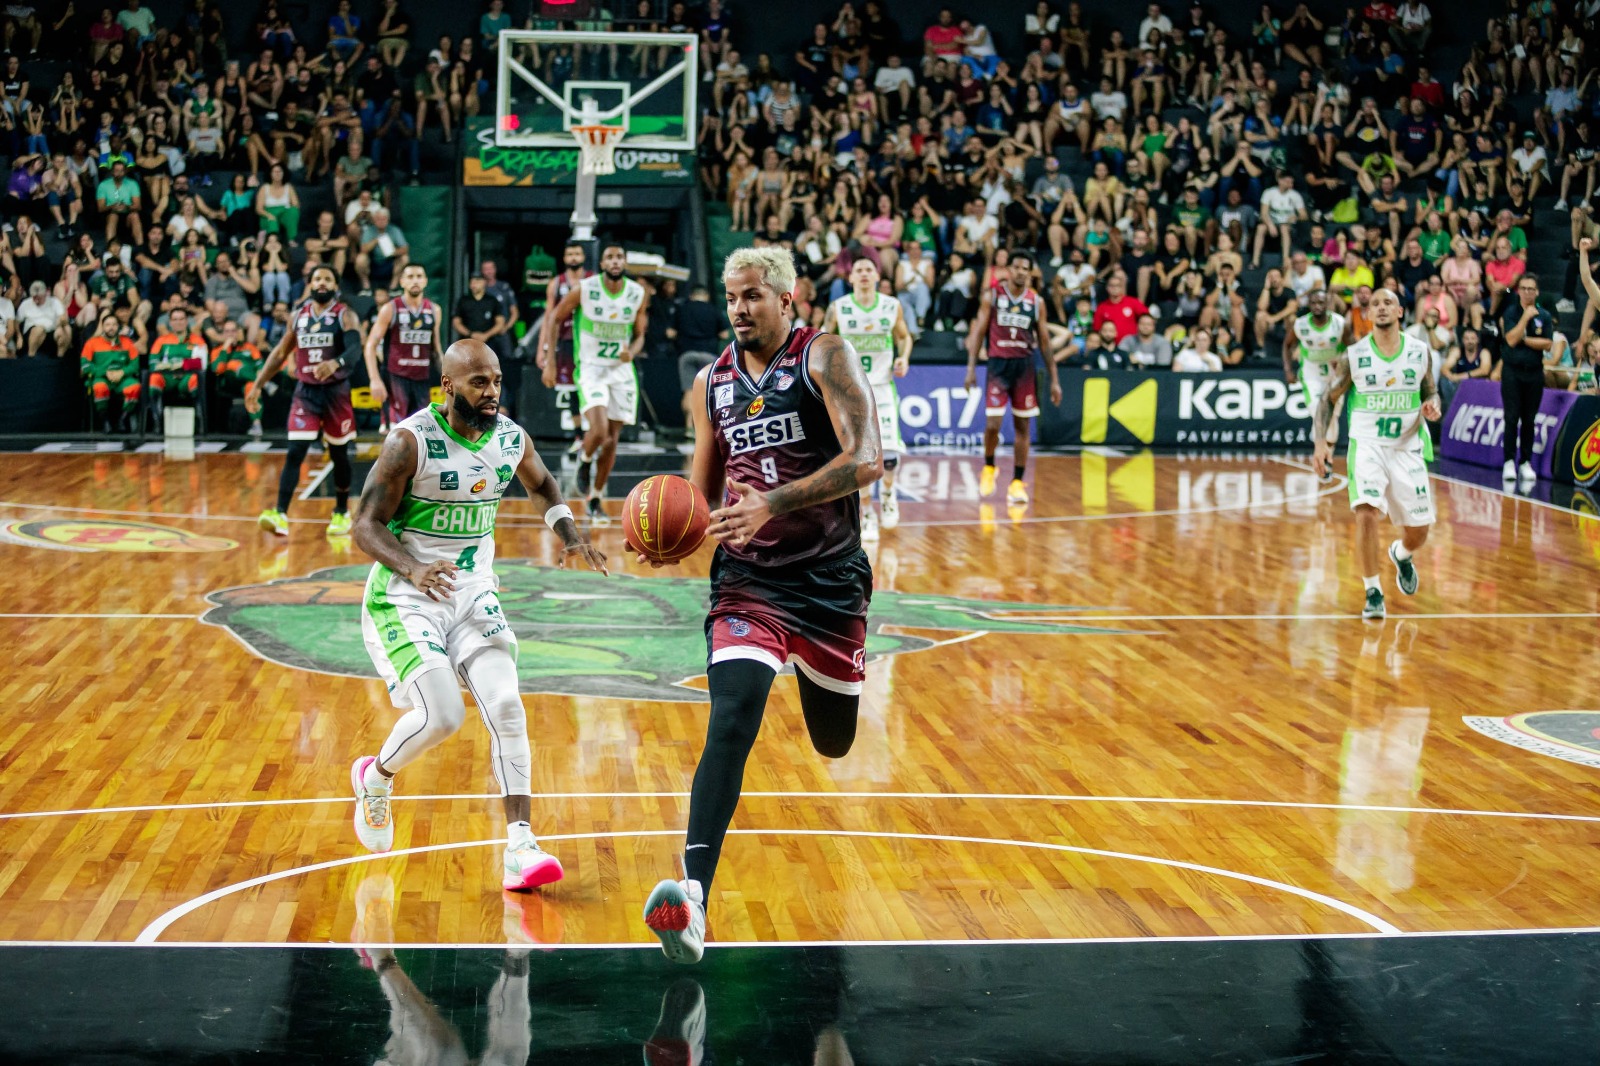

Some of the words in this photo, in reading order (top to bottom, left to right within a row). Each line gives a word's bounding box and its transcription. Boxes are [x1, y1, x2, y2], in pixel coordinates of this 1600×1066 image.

[301, 336, 330, 346] SESI
[597, 341, 621, 359] 22
[860, 355, 872, 373] 9
[715, 373, 732, 382] SESI
[1366, 392, 1413, 410] BAURU
[731, 417, 794, 451] SESI
[1176, 428, 1315, 444] PAVIMENTAÇÃ
[1375, 416, 1403, 439] 10
[1448, 403, 1558, 455] NETSS
[761, 456, 779, 484] 9
[432, 504, 496, 532] BAURU
[455, 545, 479, 573] 4
